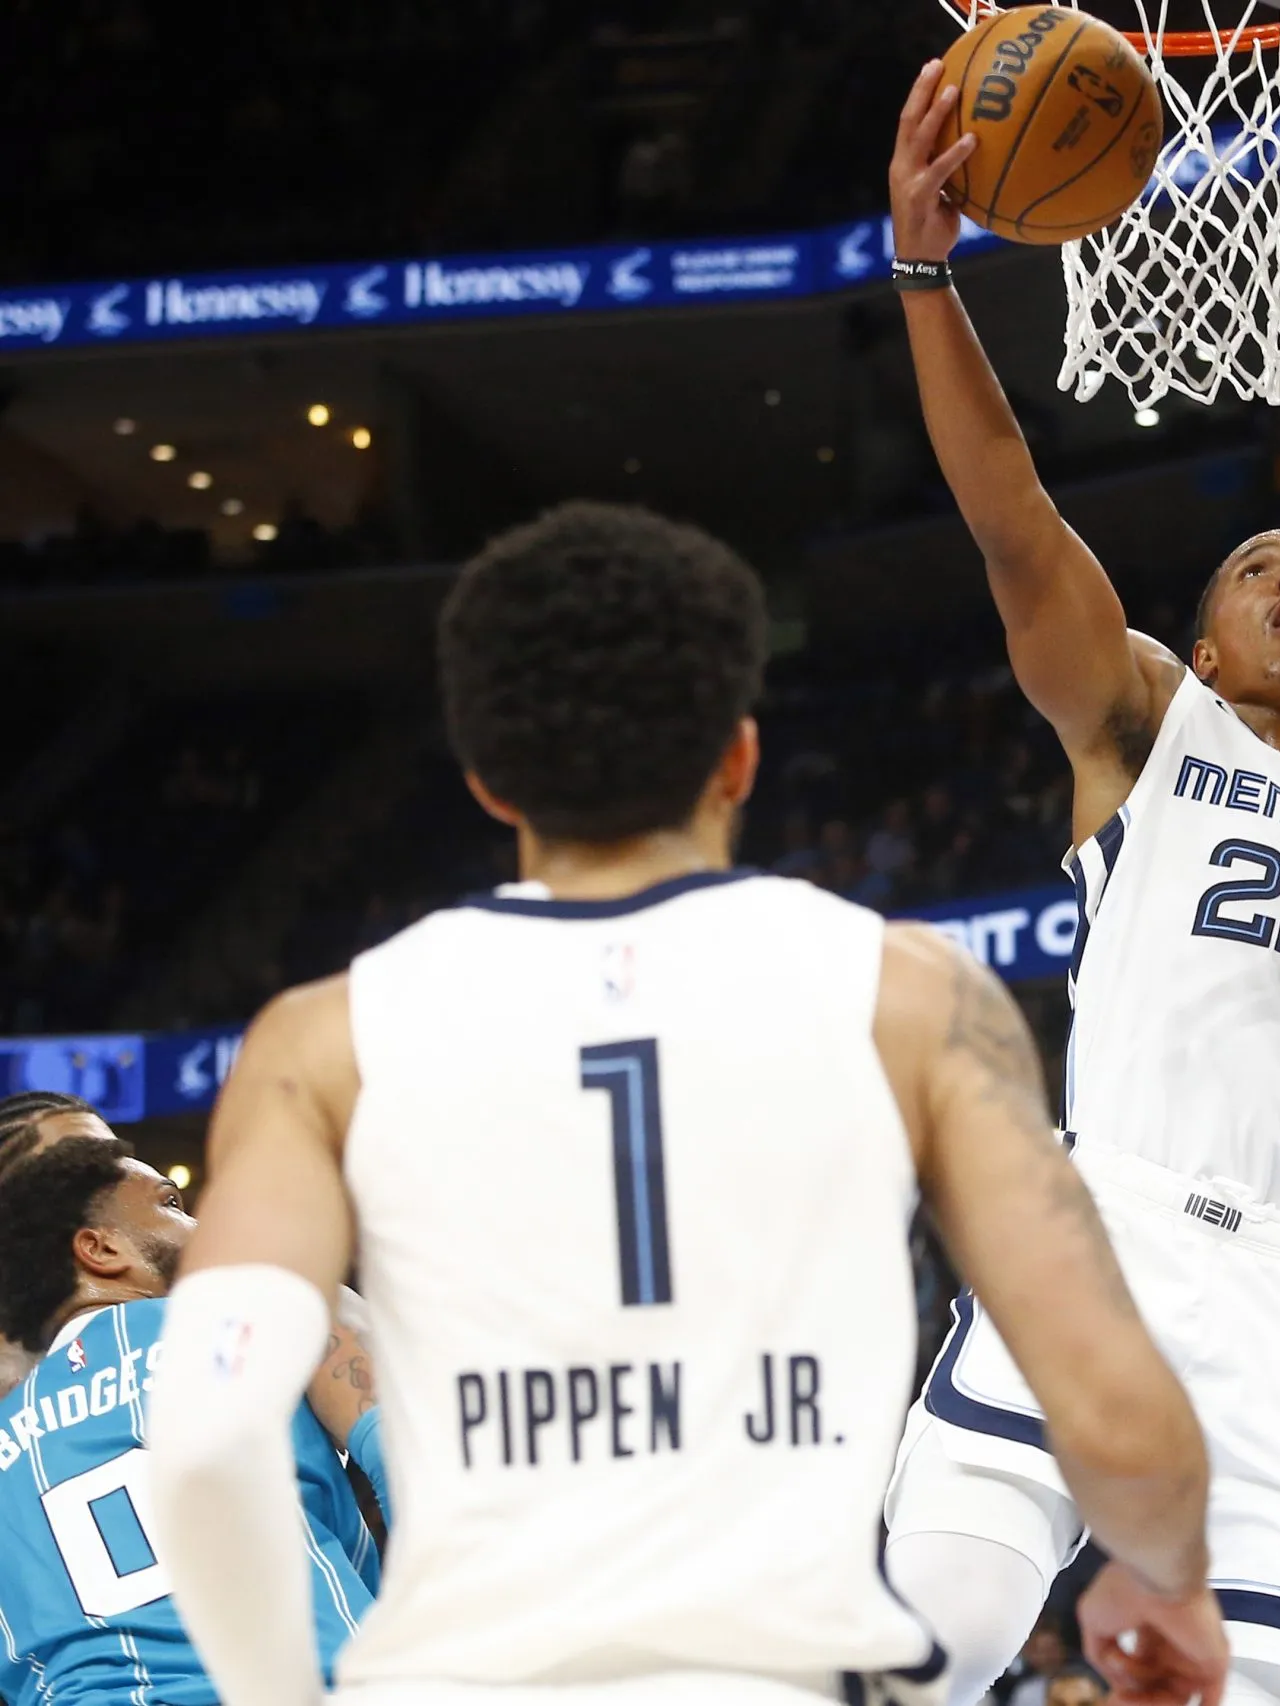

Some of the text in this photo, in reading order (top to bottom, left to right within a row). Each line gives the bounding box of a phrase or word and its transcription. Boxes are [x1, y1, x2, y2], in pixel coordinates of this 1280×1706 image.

[971, 8, 1067, 122] Wilson
[145, 279, 327, 325] Hennessy
[404, 260, 590, 308] Hennessy
[579, 1036, 673, 1306] 1
[456, 1352, 845, 1469] PIPPEN JR.
